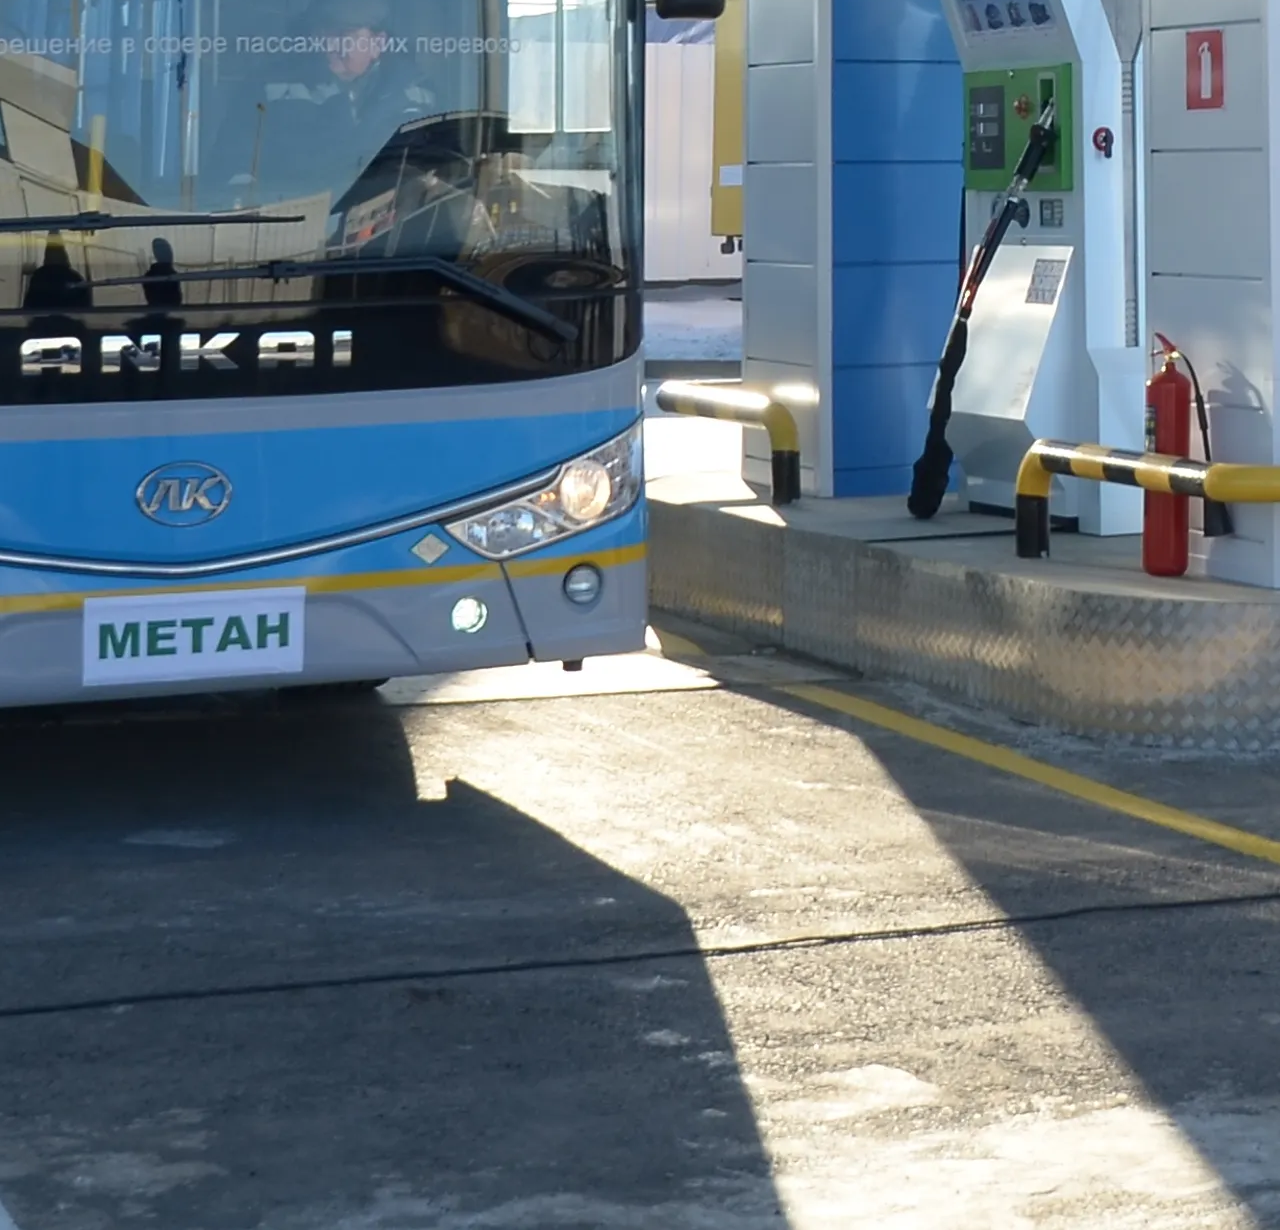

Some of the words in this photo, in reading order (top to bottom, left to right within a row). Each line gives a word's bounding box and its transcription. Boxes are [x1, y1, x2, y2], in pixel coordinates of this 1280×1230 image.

[122, 38, 135, 54] в
[144, 34, 228, 58] сфере
[236, 36, 408, 59] пассажирских
[20, 330, 353, 376] ANKAI
[97, 611, 291, 660] МЕТАН
